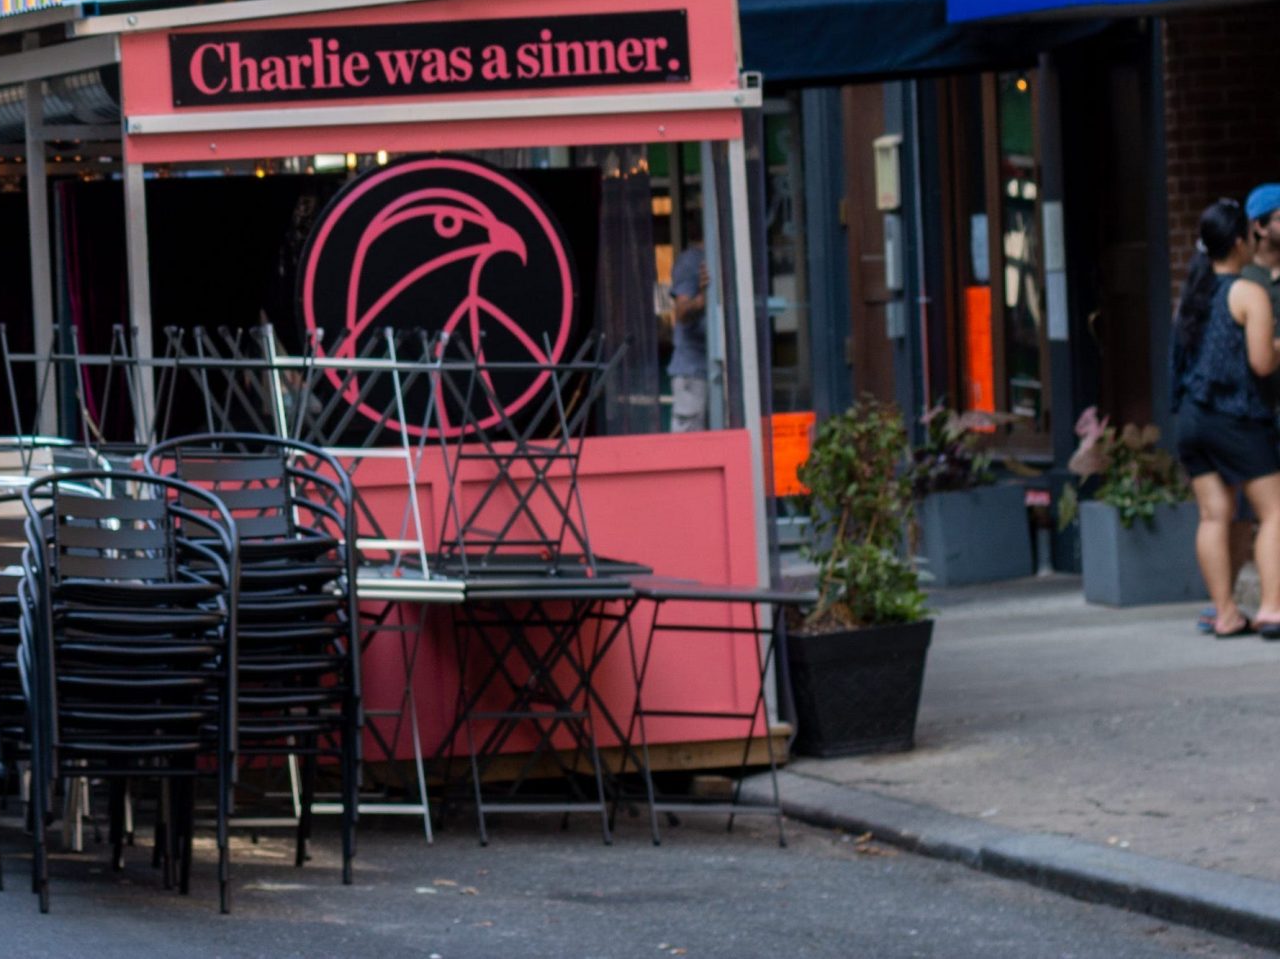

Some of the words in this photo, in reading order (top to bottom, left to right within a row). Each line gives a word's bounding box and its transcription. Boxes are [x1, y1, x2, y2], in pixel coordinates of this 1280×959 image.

[189, 38, 370, 95] Charlie
[375, 46, 473, 85] was
[481, 44, 511, 80] a
[516, 29, 680, 78] sinner.
